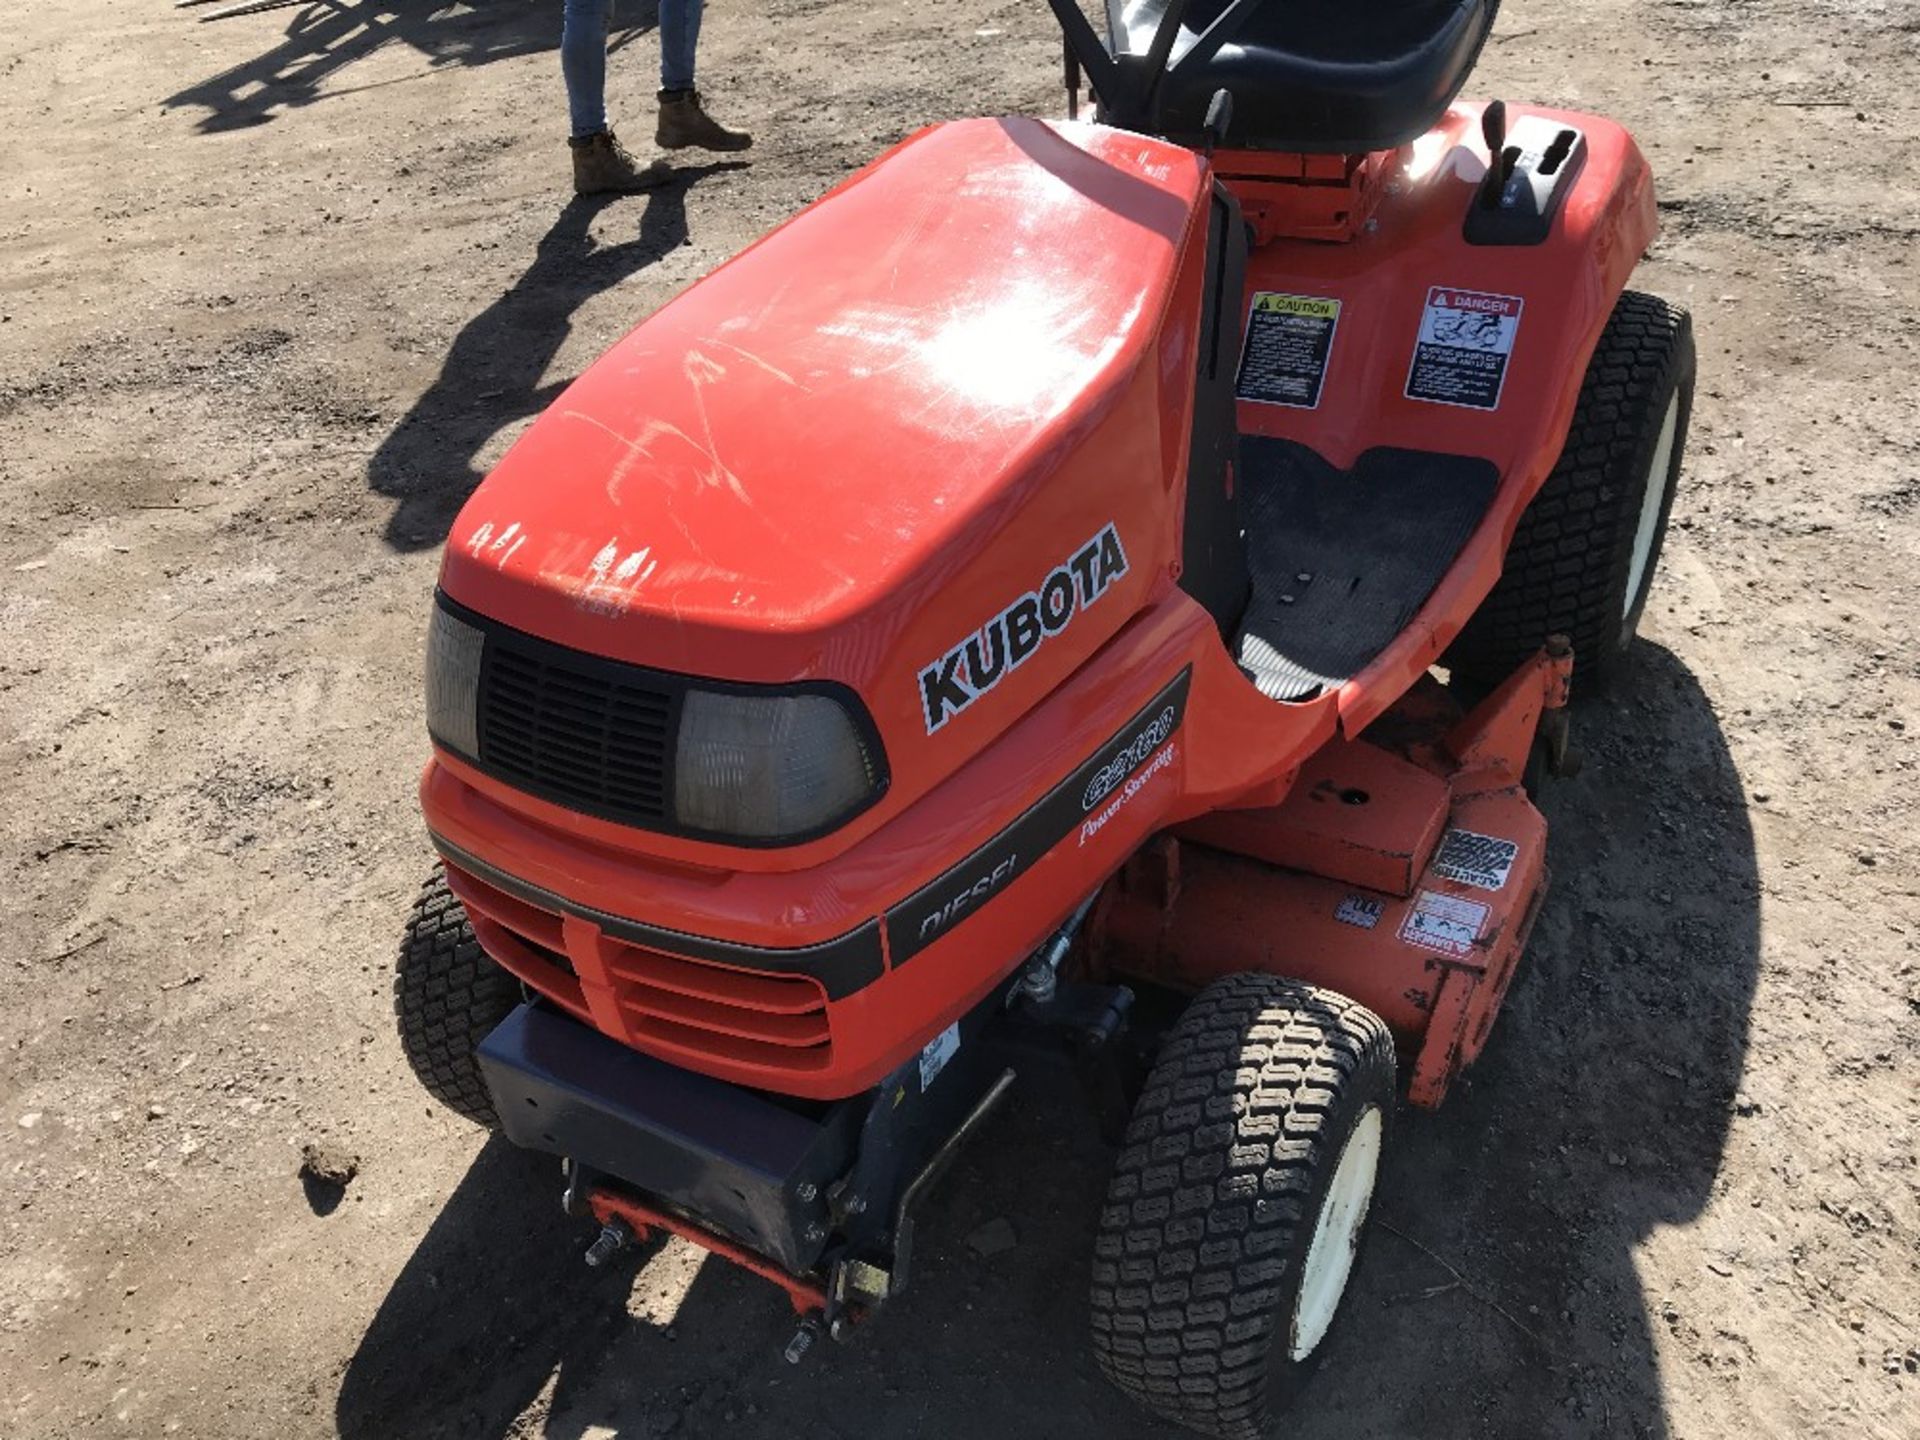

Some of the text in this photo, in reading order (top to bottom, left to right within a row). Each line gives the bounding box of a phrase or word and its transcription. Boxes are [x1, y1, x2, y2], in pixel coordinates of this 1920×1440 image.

[1276, 299, 1330, 314] CAUTION
[1455, 297, 1510, 313] DANGER
[918, 521, 1129, 735] KUBOTA
